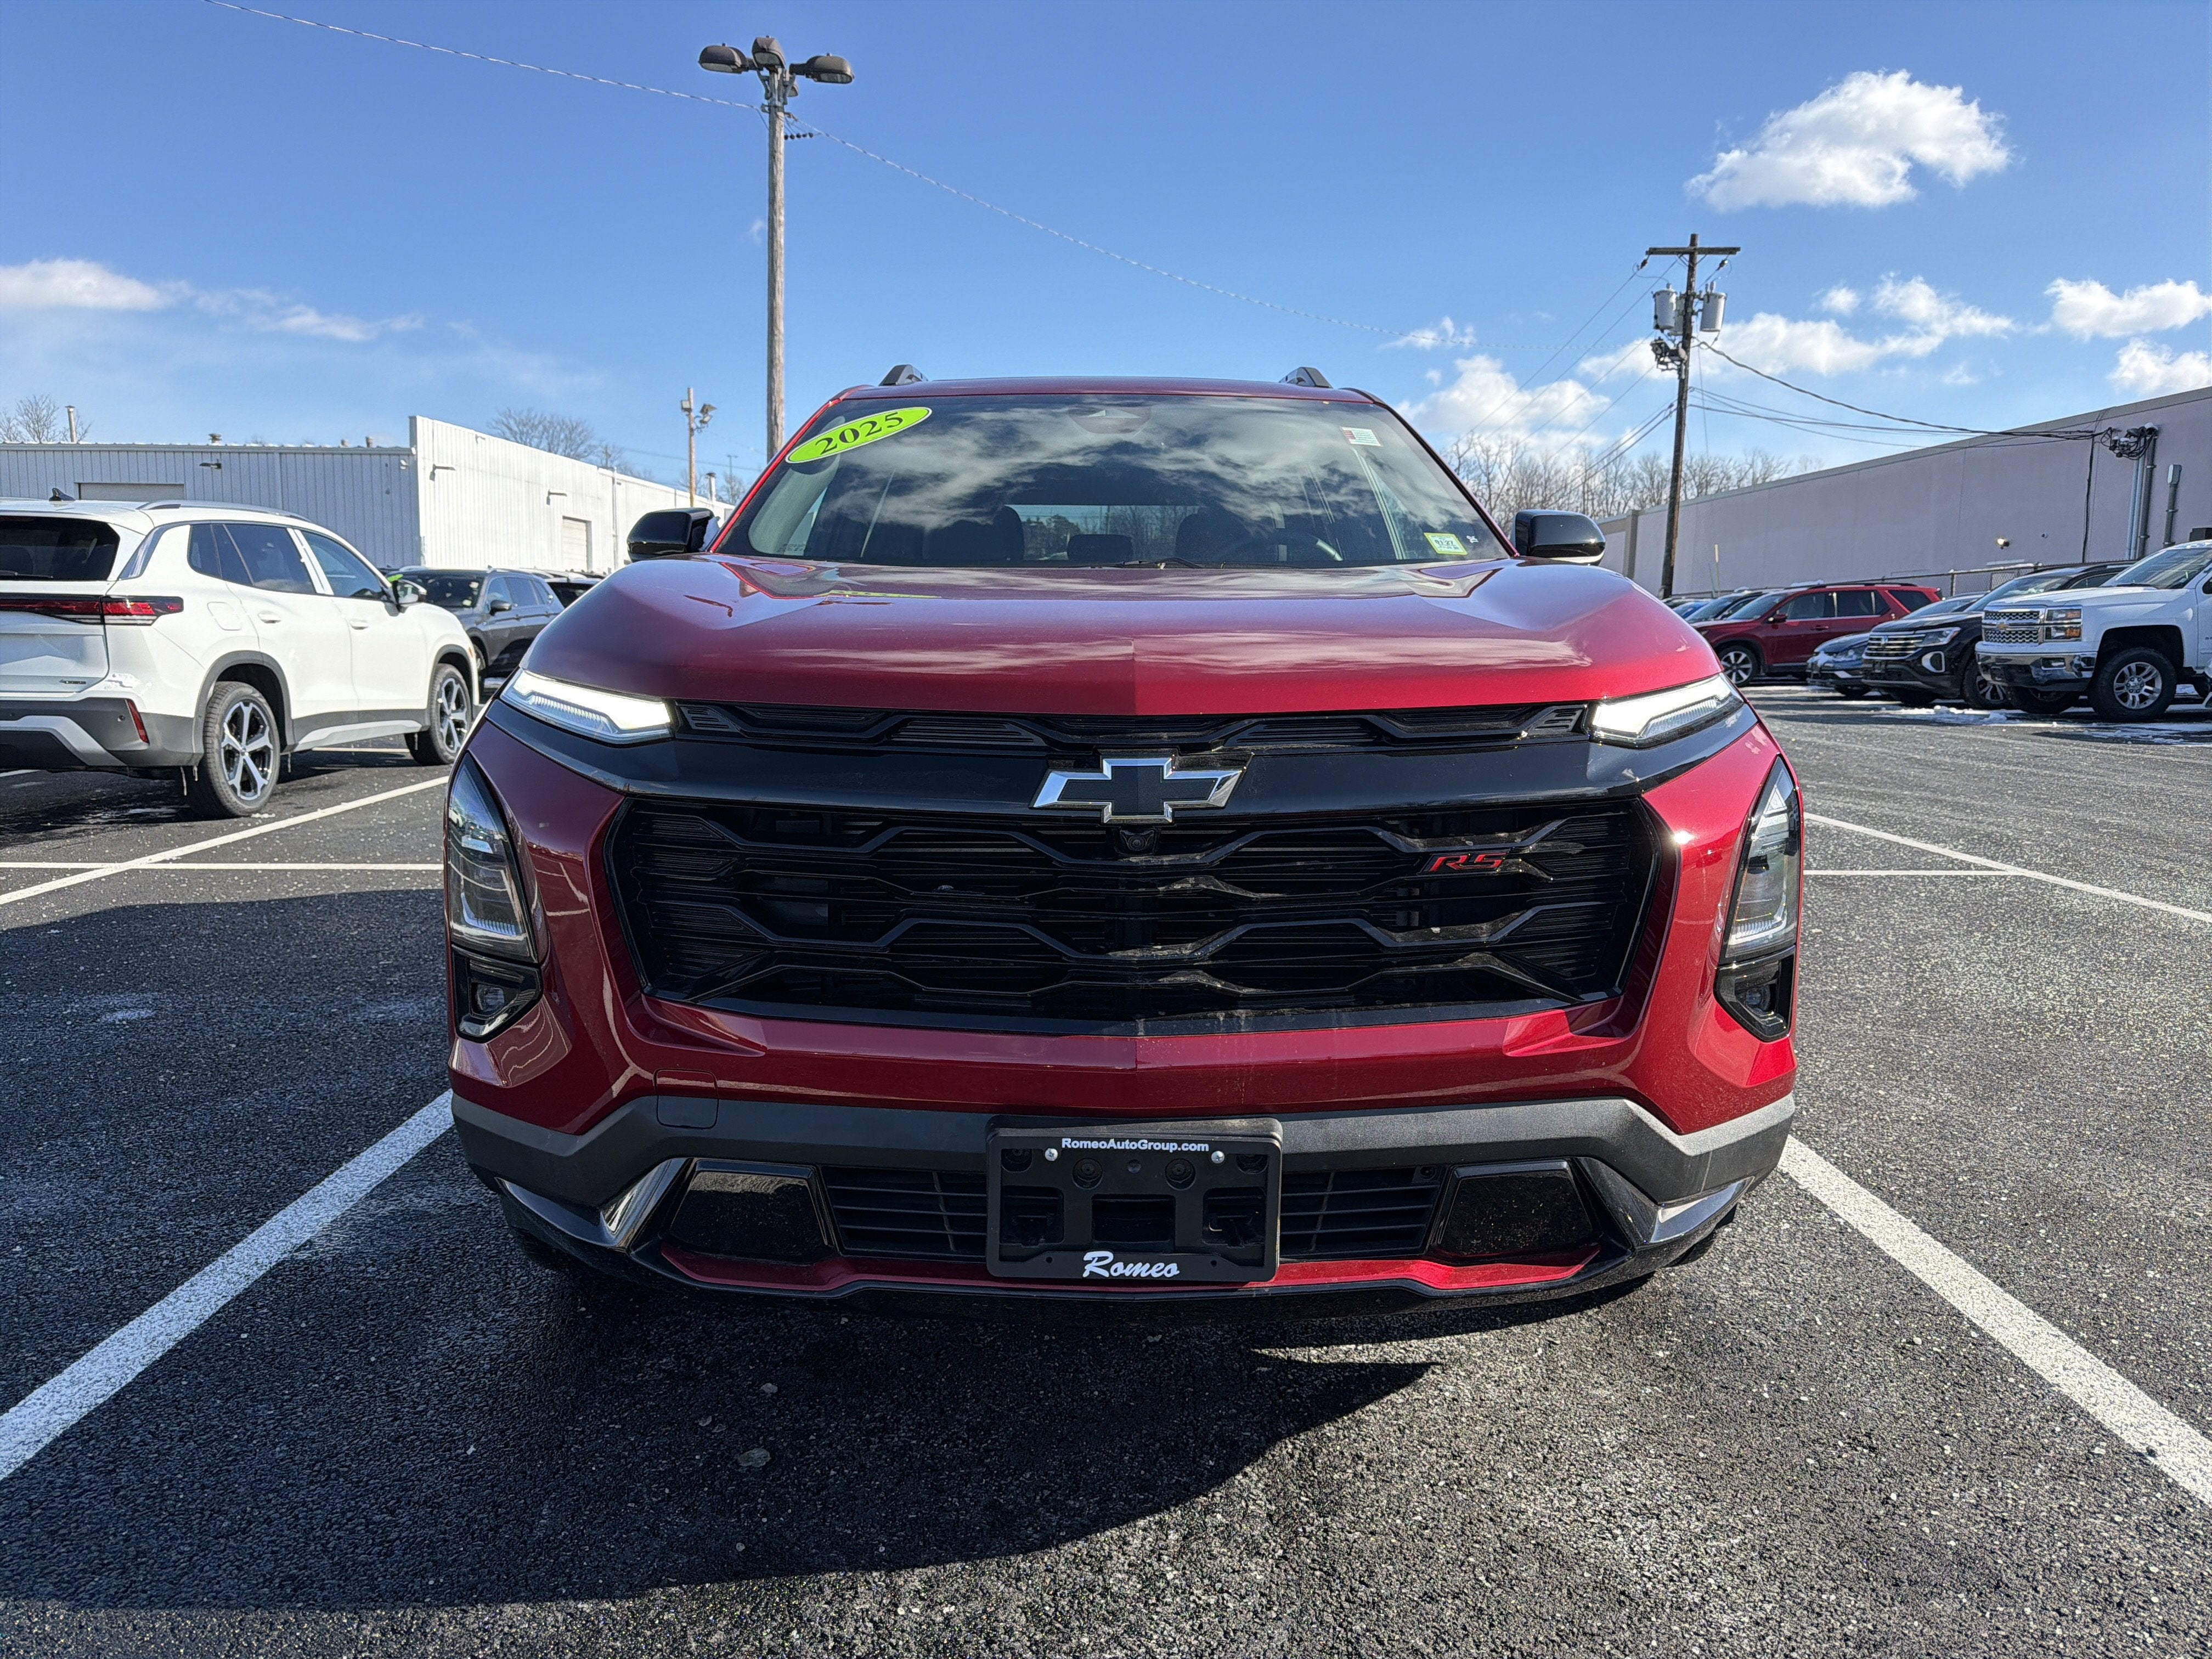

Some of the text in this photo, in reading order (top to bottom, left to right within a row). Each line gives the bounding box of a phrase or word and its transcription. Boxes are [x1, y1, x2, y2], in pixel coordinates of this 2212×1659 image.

[815, 412, 904, 455] 2025
[1429, 853, 1508, 872] RS
[1062, 1138, 1209, 1152] RomeoAutoGroup.com
[1082, 1251, 1180, 1278] Romeo
